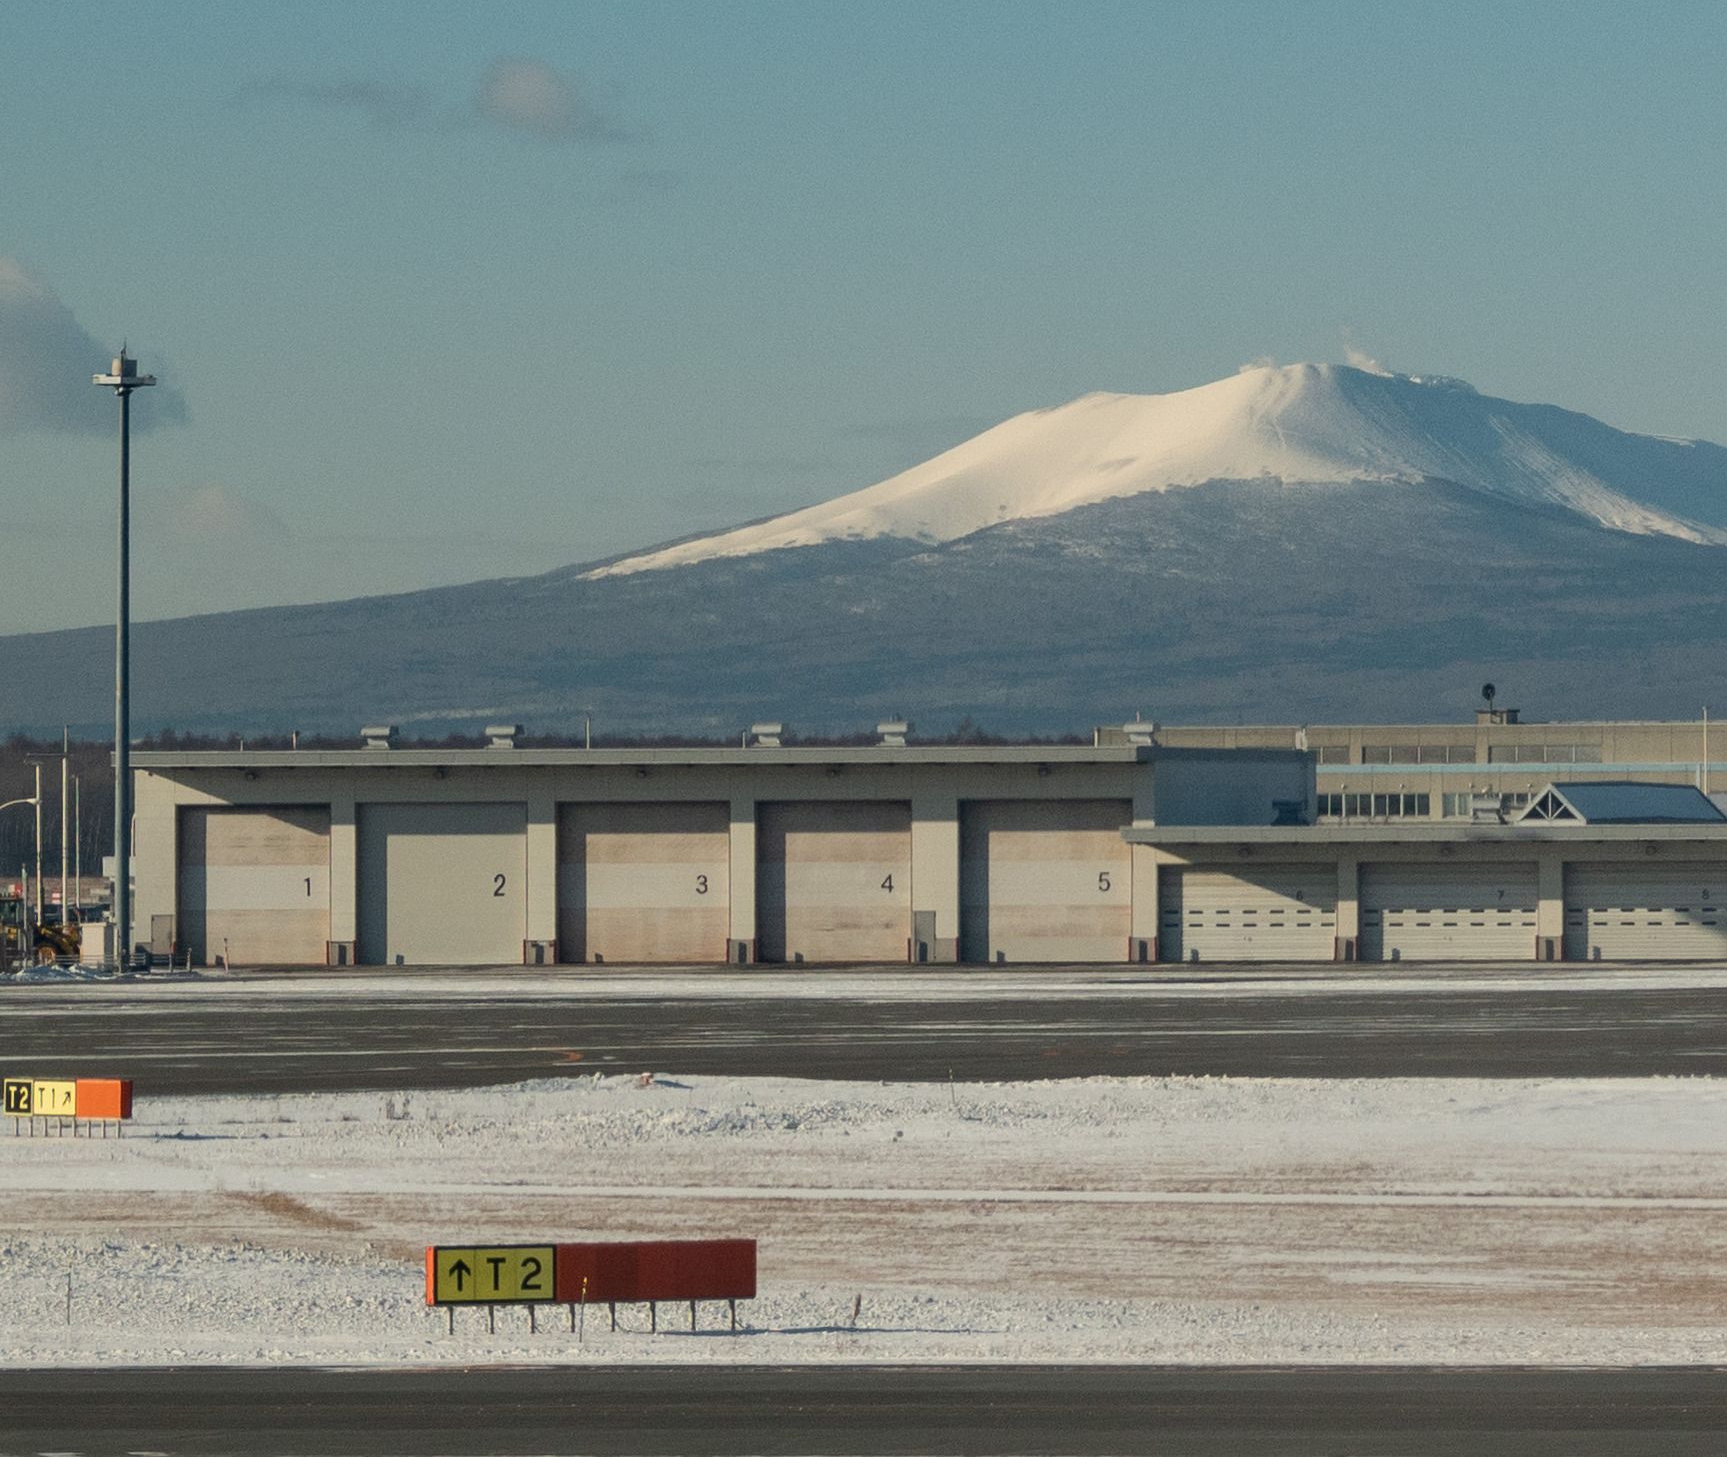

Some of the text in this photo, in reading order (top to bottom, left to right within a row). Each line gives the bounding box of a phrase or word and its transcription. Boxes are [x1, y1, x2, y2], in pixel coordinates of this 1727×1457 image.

[304, 877, 311, 896] 1
[493, 874, 506, 897] 2
[695, 874, 708, 894] 3
[880, 874, 894, 893] 4
[1098, 872, 1111, 892] 5
[1497, 889, 1505, 901] 7
[9, 1086, 55, 1110] T2 T1
[486, 1256, 543, 1292] T2
